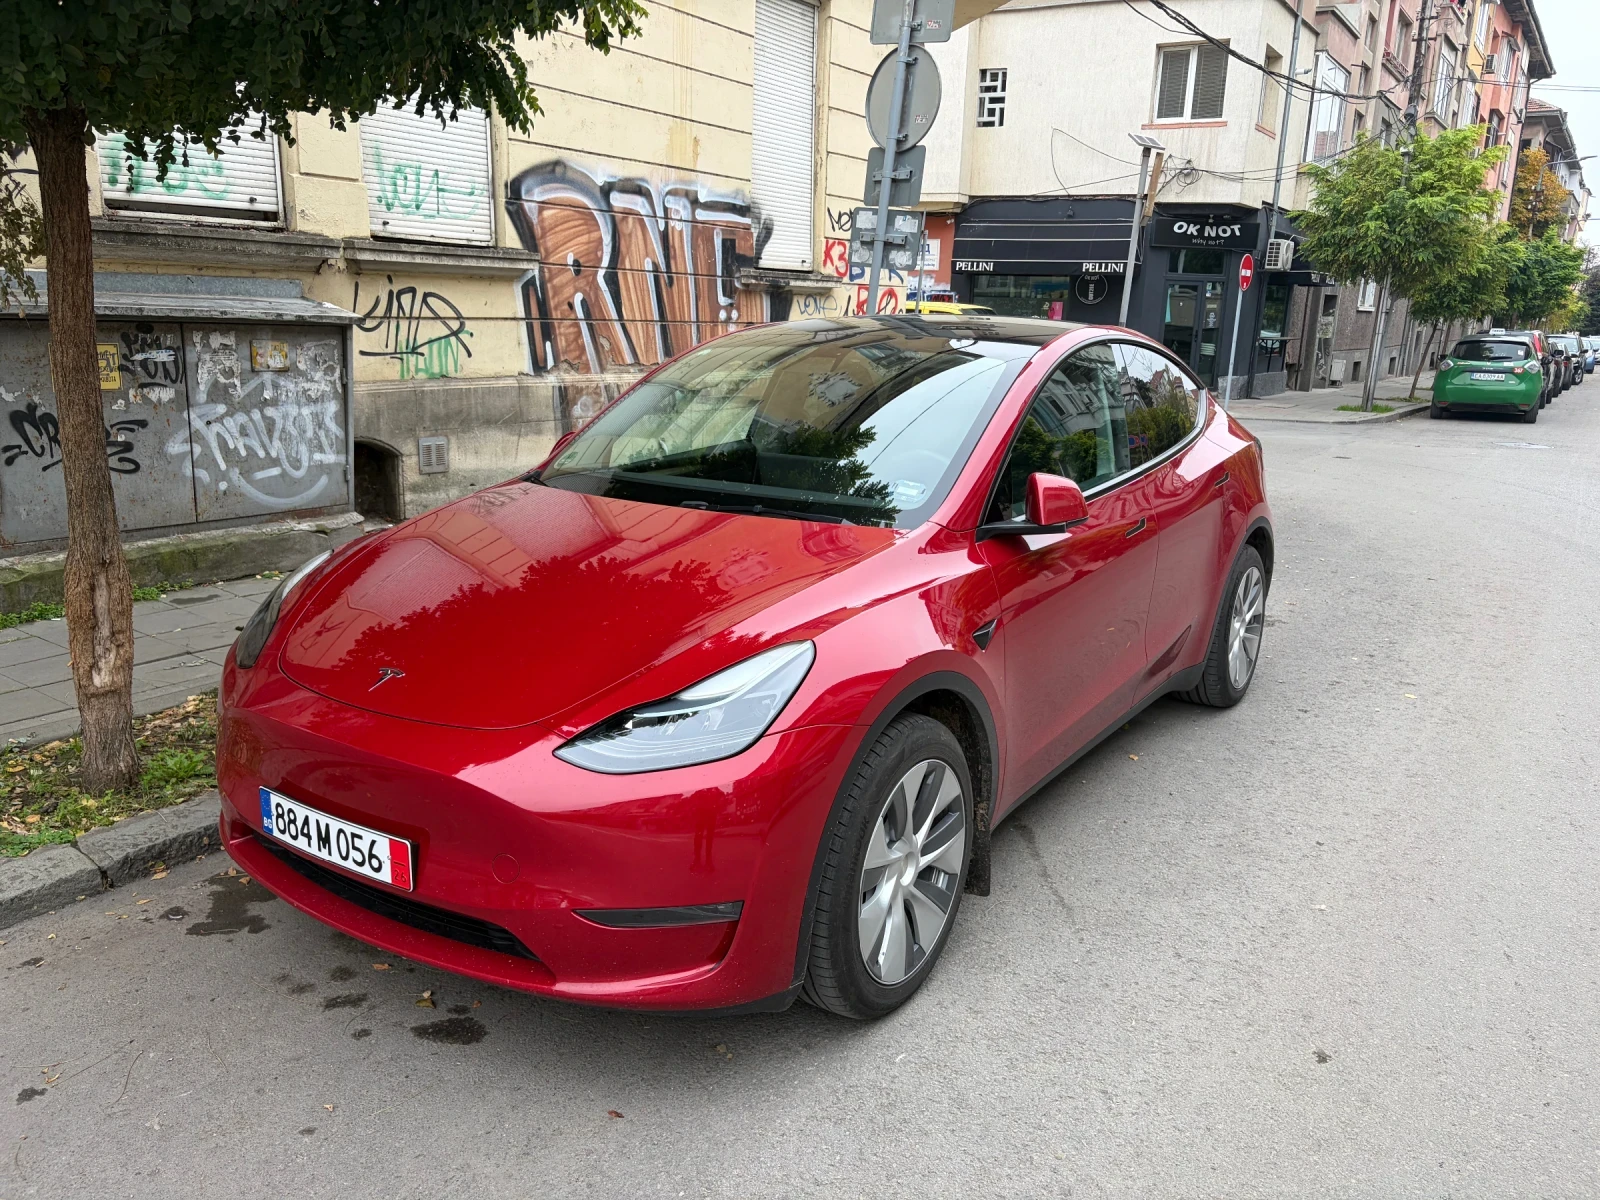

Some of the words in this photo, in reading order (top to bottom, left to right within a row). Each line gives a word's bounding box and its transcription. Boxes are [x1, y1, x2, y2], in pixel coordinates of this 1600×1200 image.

[1173, 221, 1200, 236] OK
[1204, 224, 1241, 237] NOT
[956, 261, 994, 272] PELLINI
[1082, 262, 1124, 273] PELLINI
[263, 816, 273, 829] BG
[275, 802, 313, 848] 884
[315, 819, 333, 857] M
[336, 827, 383, 874] 056
[394, 869, 407, 883] 26
